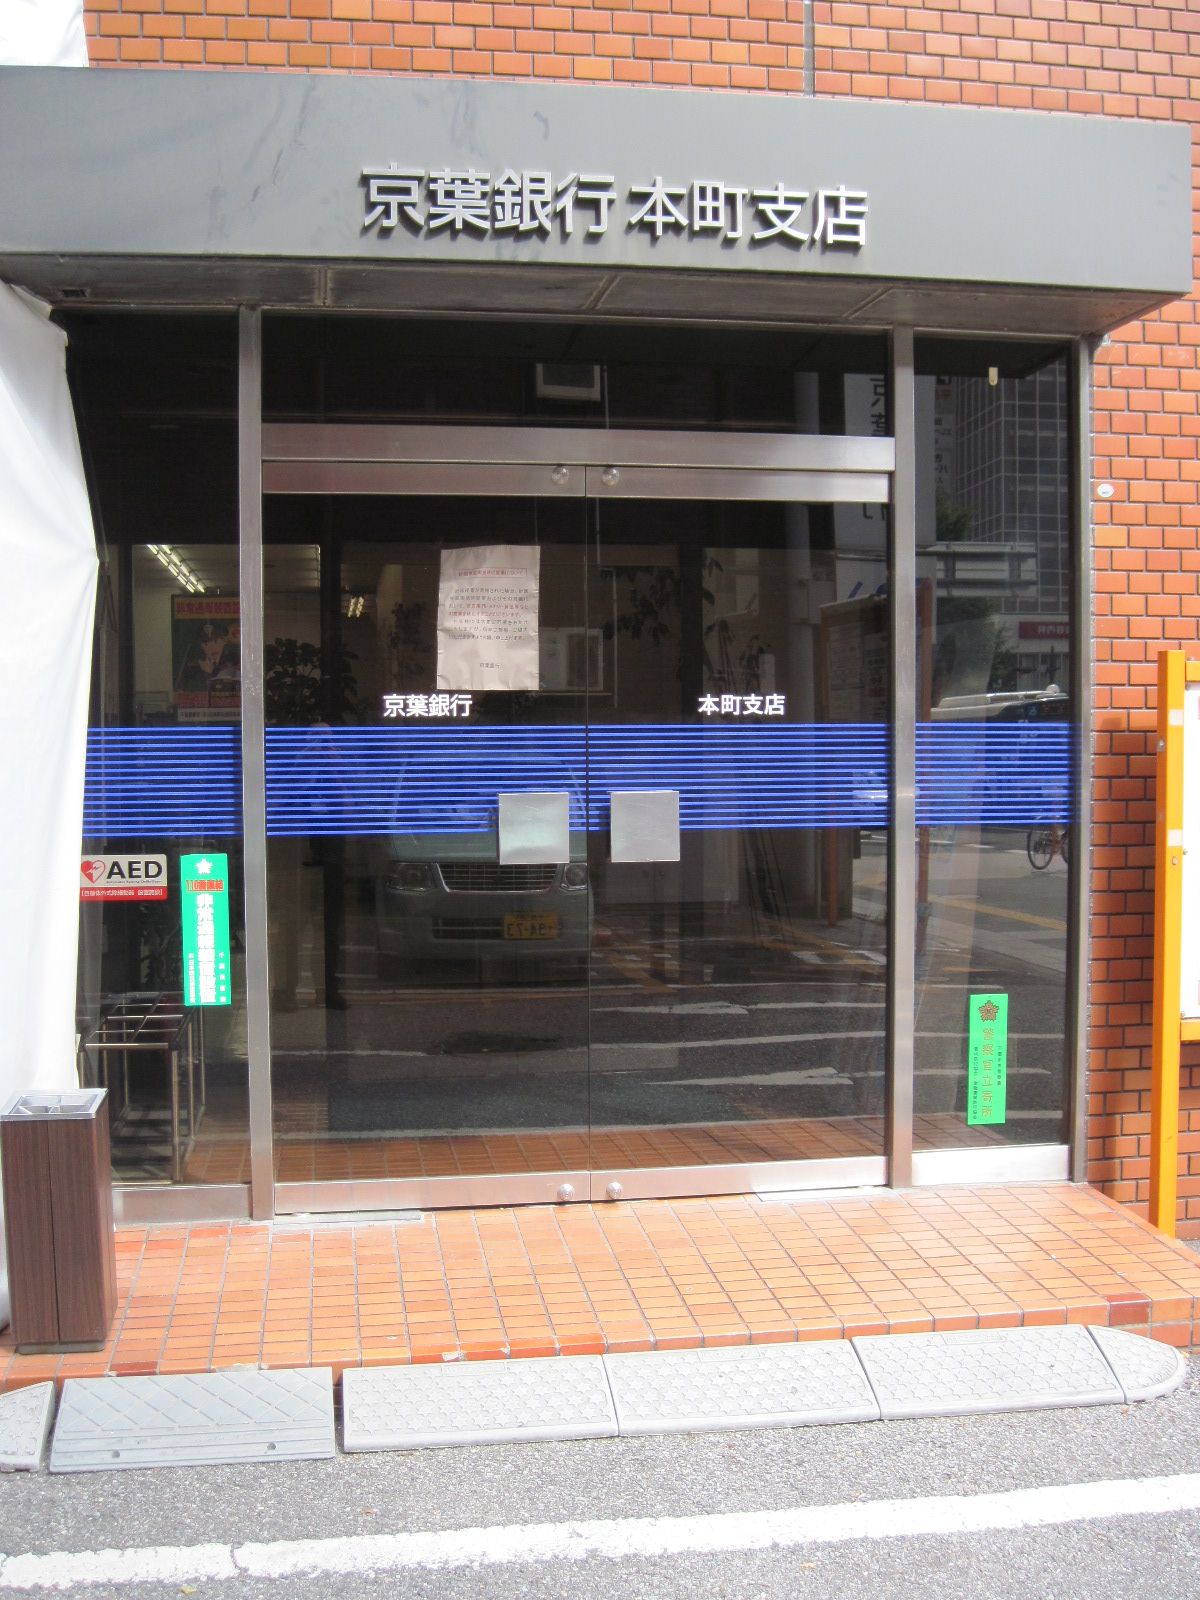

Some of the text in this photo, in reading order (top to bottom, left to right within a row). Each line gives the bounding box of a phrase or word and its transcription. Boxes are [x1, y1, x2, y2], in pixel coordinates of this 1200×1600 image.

[362, 163, 869, 247] 京葉銀行 本町支店
[383, 694, 473, 717] 京葉銀行
[698, 693, 786, 716] 本町支店
[106, 860, 163, 880] AED
